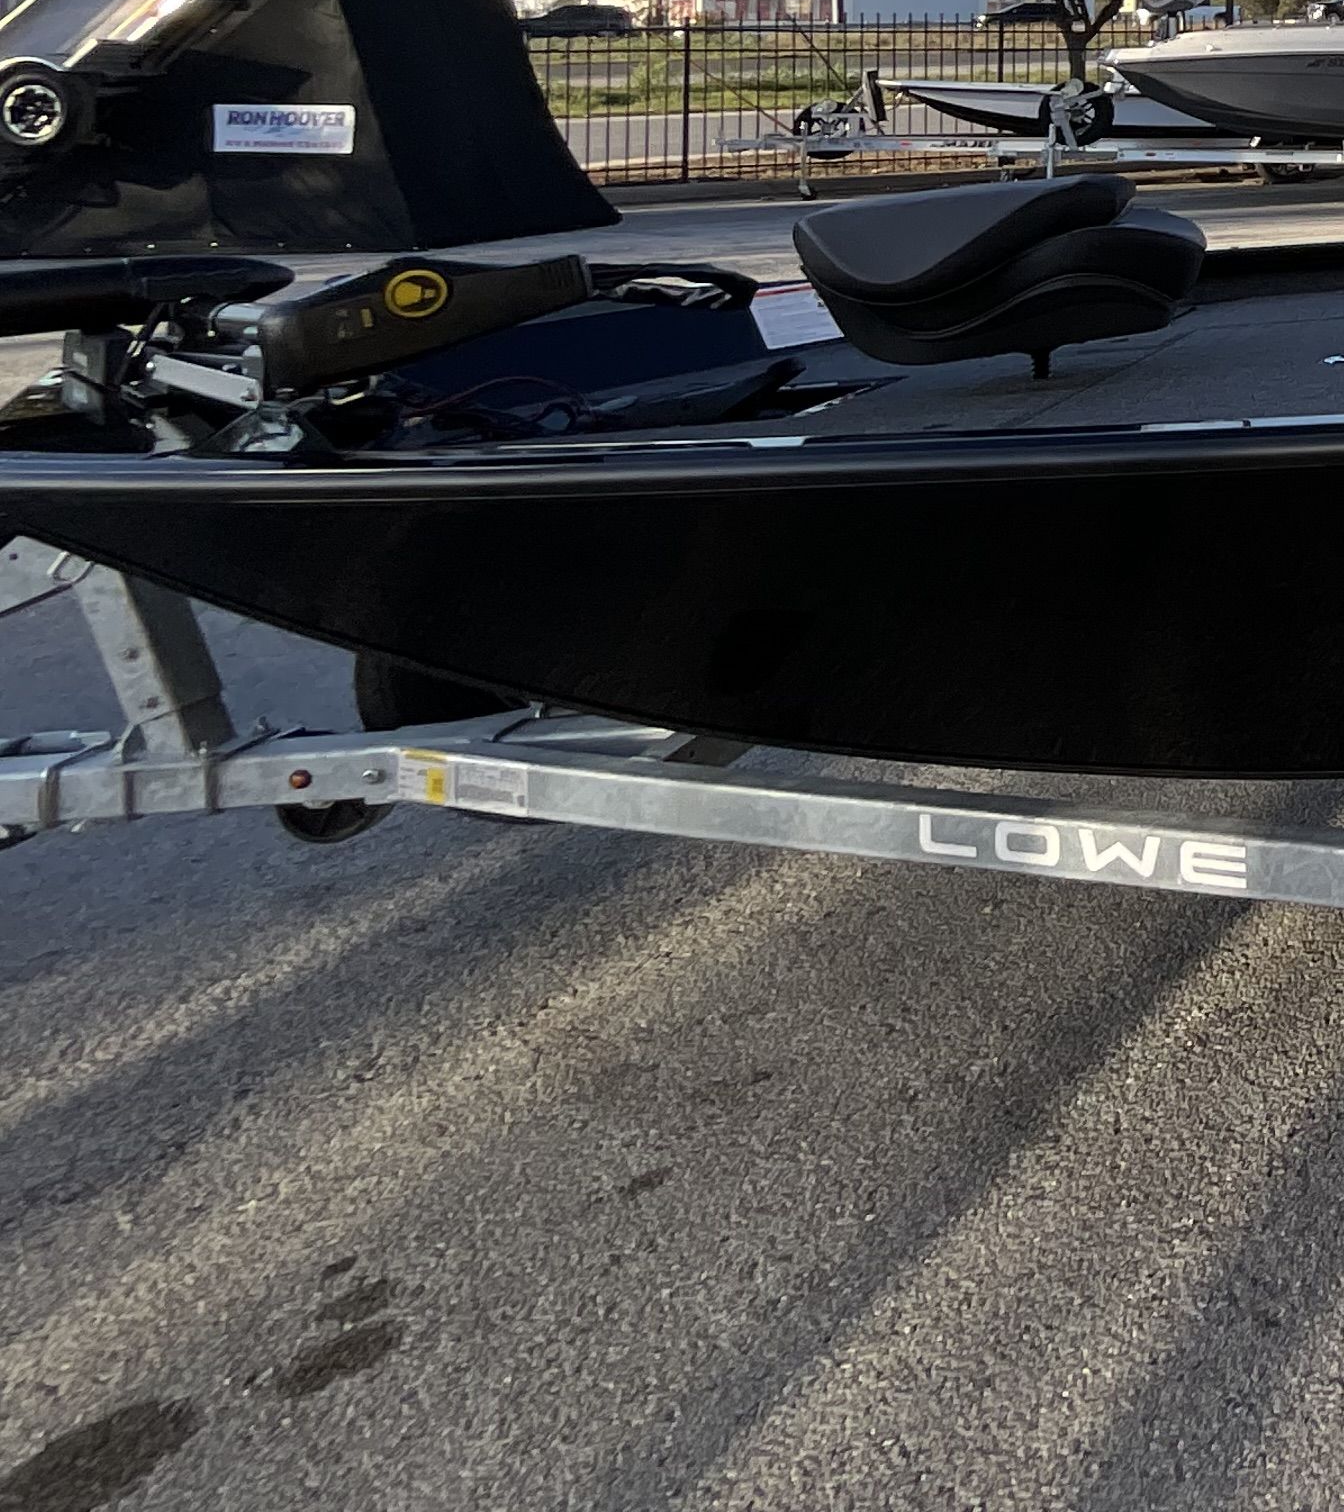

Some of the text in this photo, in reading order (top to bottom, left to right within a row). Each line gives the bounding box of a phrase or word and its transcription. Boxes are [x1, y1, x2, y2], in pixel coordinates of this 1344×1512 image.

[228, 110, 346, 126] RON HOOVER
[919, 814, 1248, 889] LOWE
